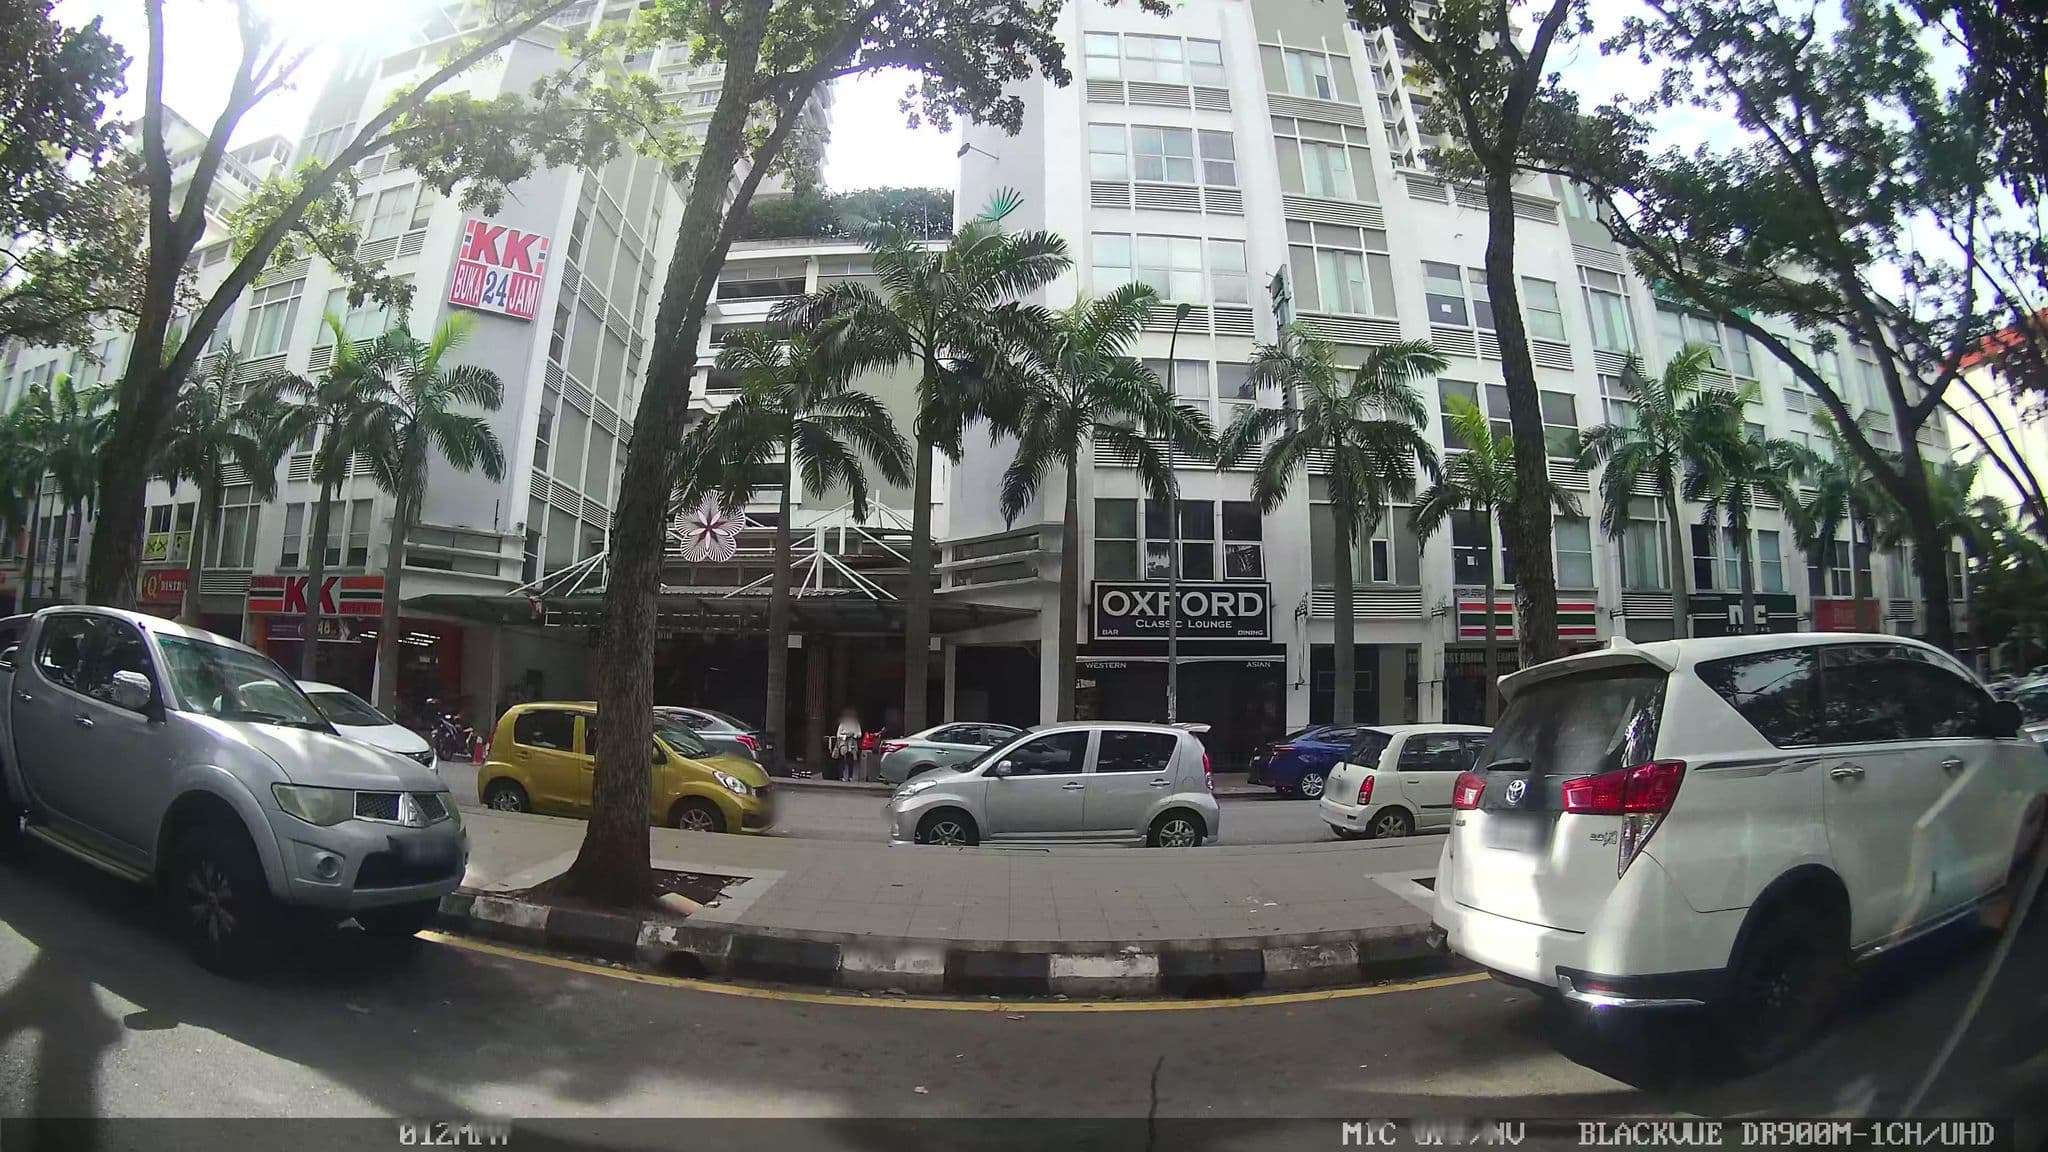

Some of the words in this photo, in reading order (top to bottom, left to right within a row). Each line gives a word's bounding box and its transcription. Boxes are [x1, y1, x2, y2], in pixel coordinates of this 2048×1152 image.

[468, 221, 542, 273] KK
[453, 264, 484, 304] BUKA
[482, 271, 509, 307] 24
[509, 277, 538, 314] JAM
[284, 576, 340, 614] KK
[1102, 590, 1264, 617] OXFORD
[1135, 619, 1183, 629] CLASSC
[1187, 619, 1233, 629] LOUNGE
